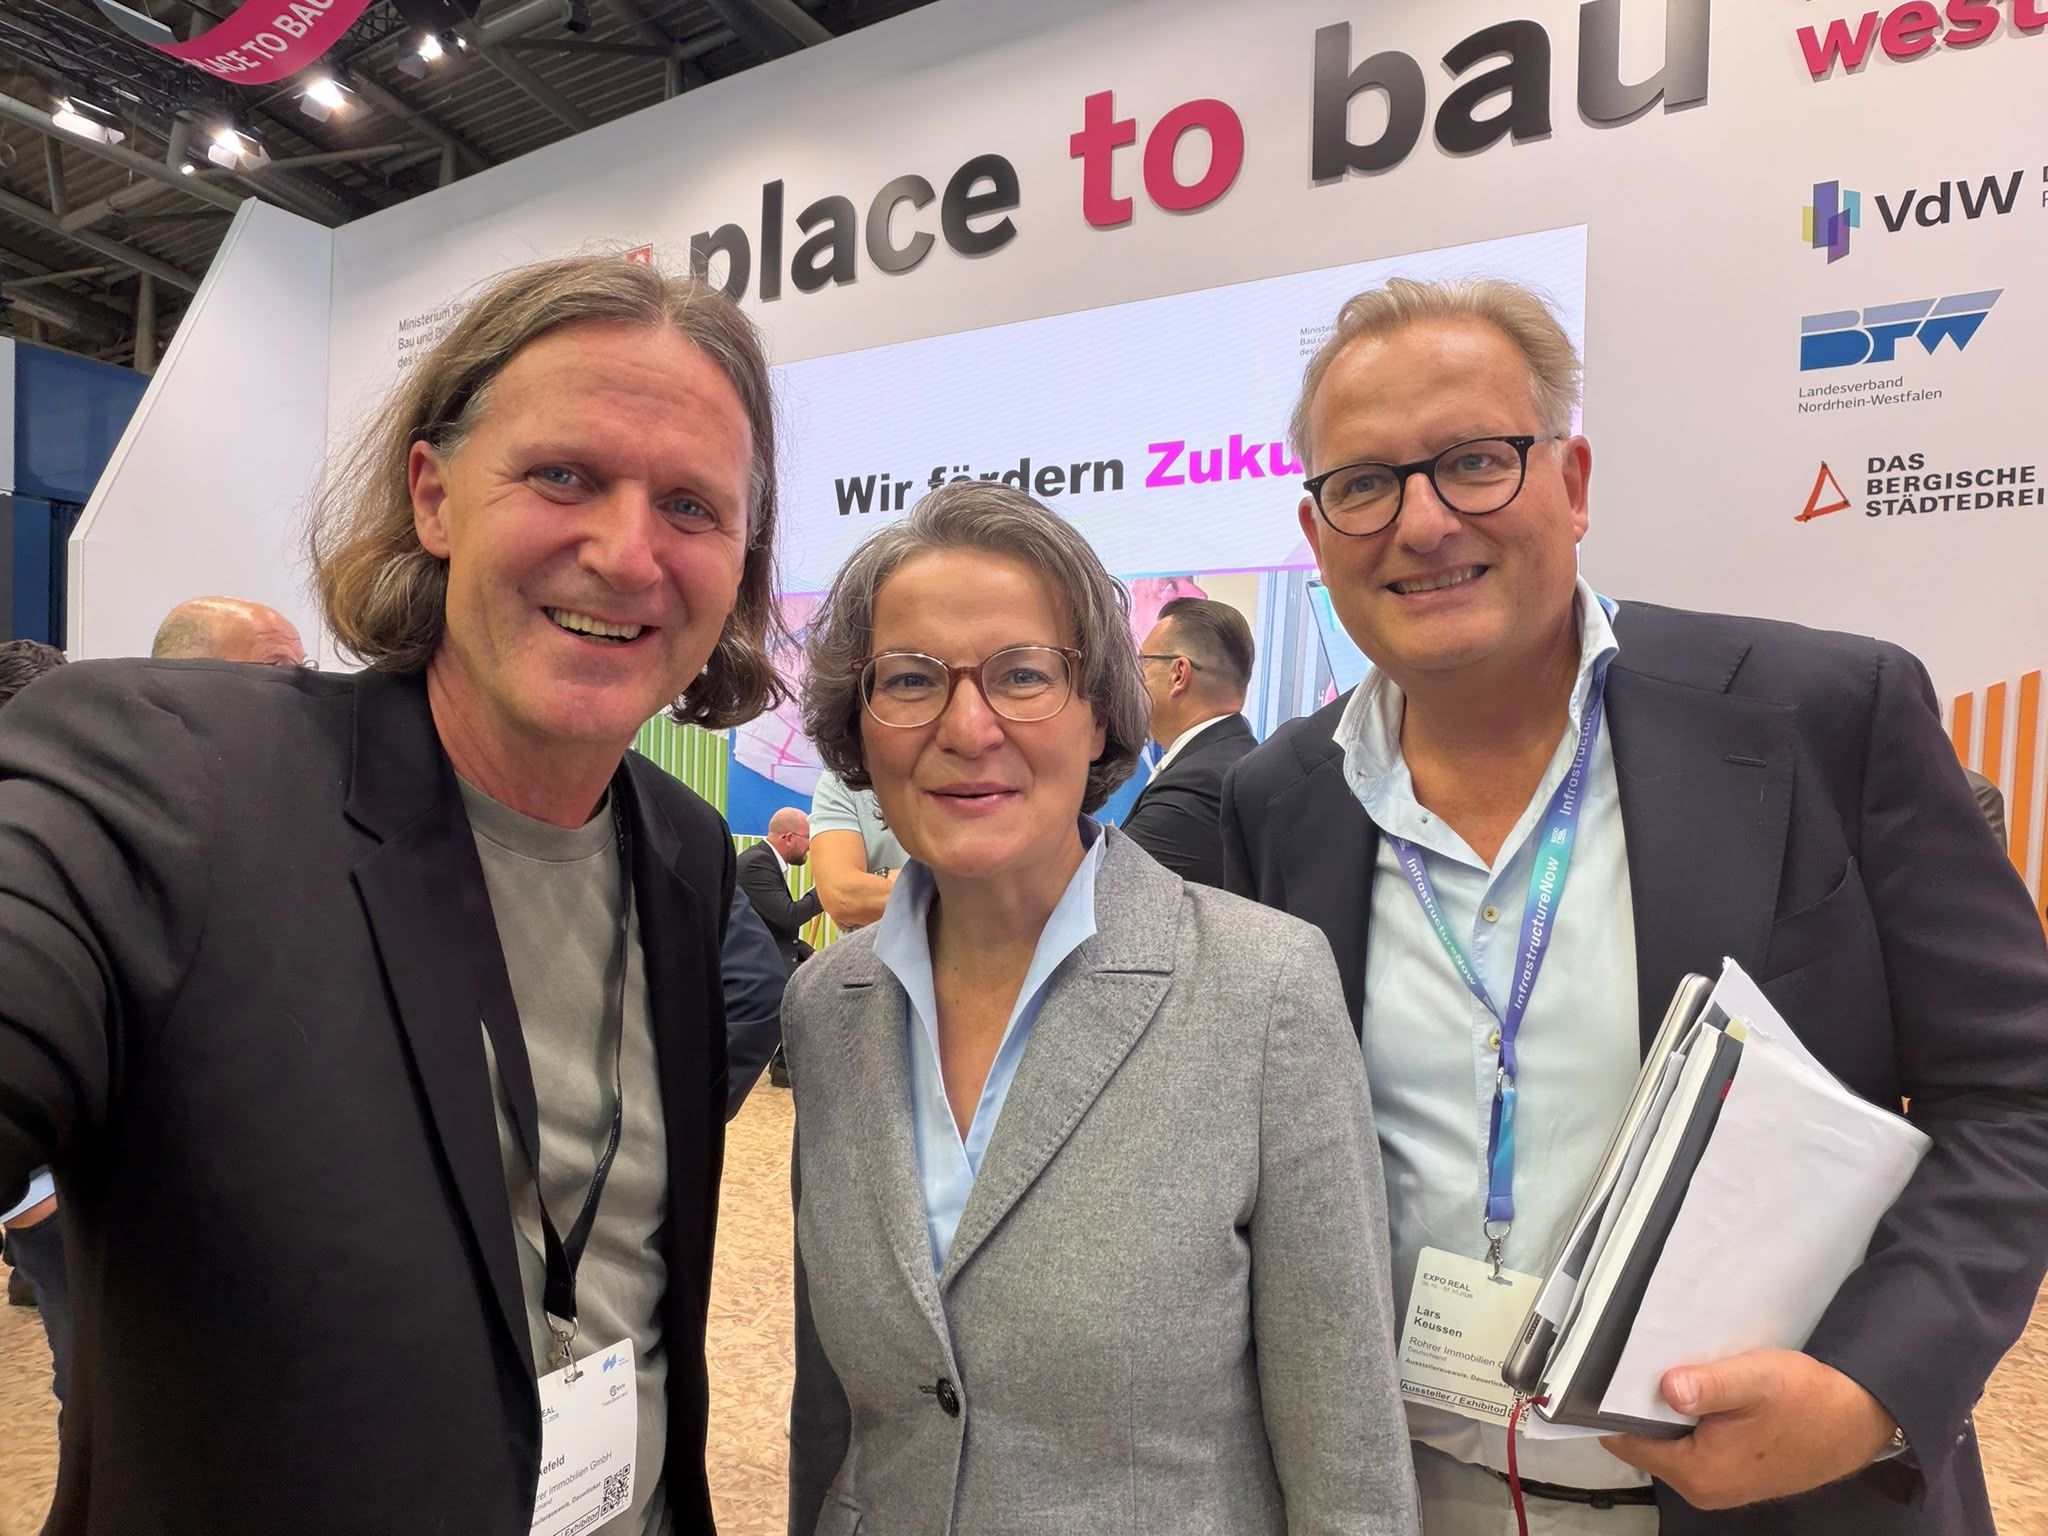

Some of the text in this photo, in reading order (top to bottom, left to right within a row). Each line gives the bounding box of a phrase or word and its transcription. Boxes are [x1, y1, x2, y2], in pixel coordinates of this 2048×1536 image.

[240, 32, 289, 60] TO
[690, 0, 1711, 304] place to bau
[1874, 170, 2025, 233] VdW
[399, 308, 450, 333] Ministerium
[398, 337, 415, 350] Bau
[1798, 388, 1943, 414] Nordrhein-Westfalen
[1799, 376, 1904, 398] Landesverband
[834, 473, 913, 516] Wir
[1145, 434, 1304, 488] Zuku
[1867, 453, 1925, 474] DAS
[1866, 465, 2036, 496] BERGISCHE
[1865, 487, 2045, 518] STÄDTEDREI
[1406, 857, 1477, 986] InfrastructureNow
[1514, 856, 1560, 1010] InfrastructureNow
[1423, 1272, 1471, 1292] EXPO REAL
[1413, 1316, 1463, 1338] Keussen
[1416, 1305, 1441, 1320] Lars
[1409, 1336, 1442, 1353] Rohrer
[1444, 1346, 1496, 1367] Immobilien
[541, 1406, 556, 1418] EAL
[1401, 1381, 1450, 1401] Aussteller
[1459, 1396, 1505, 1415] Exhibitor
[548, 1466, 589, 1495] Immobilien
[589, 1449, 613, 1471] GmbH
